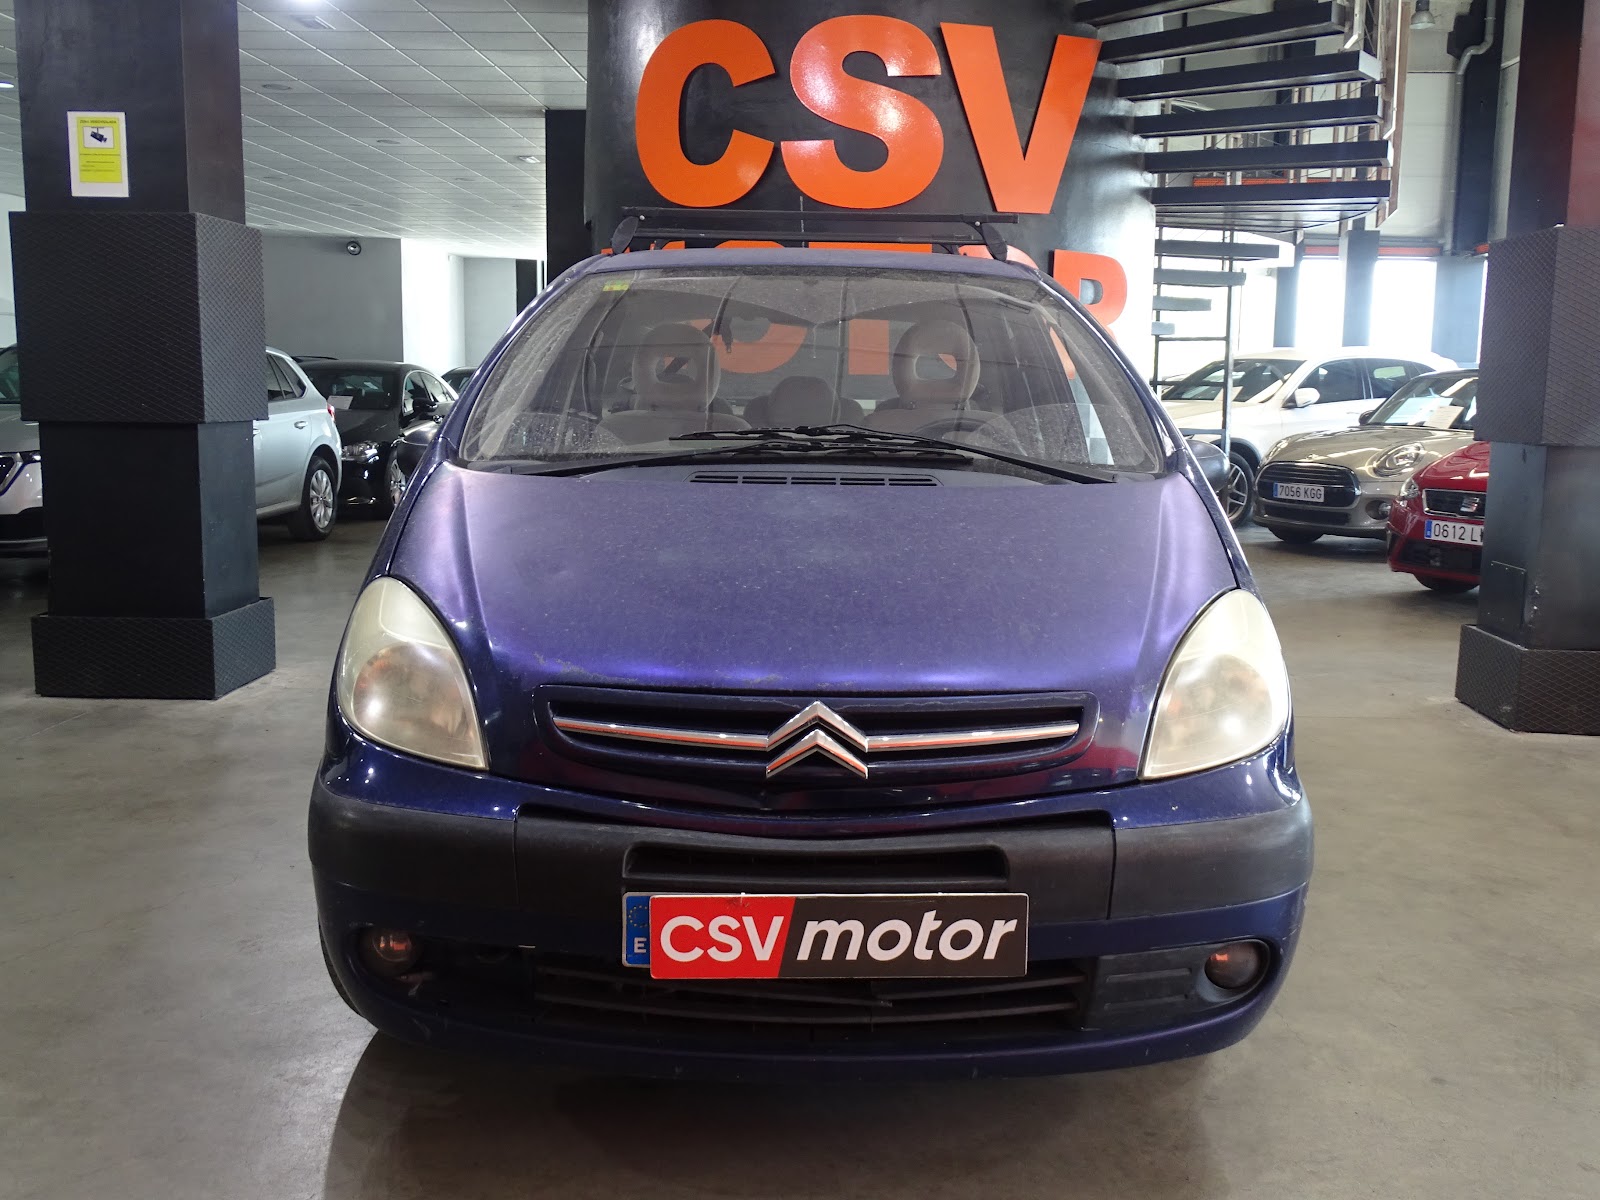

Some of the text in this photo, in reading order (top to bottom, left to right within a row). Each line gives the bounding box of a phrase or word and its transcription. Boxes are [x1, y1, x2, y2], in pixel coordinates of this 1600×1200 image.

[635, 14, 1102, 214] CSV
[1279, 485, 1322, 499] 7056 KGG
[1433, 523, 1466, 541] 0612
[660, 909, 1018, 962] CSV motor
[633, 937, 647, 953] E
